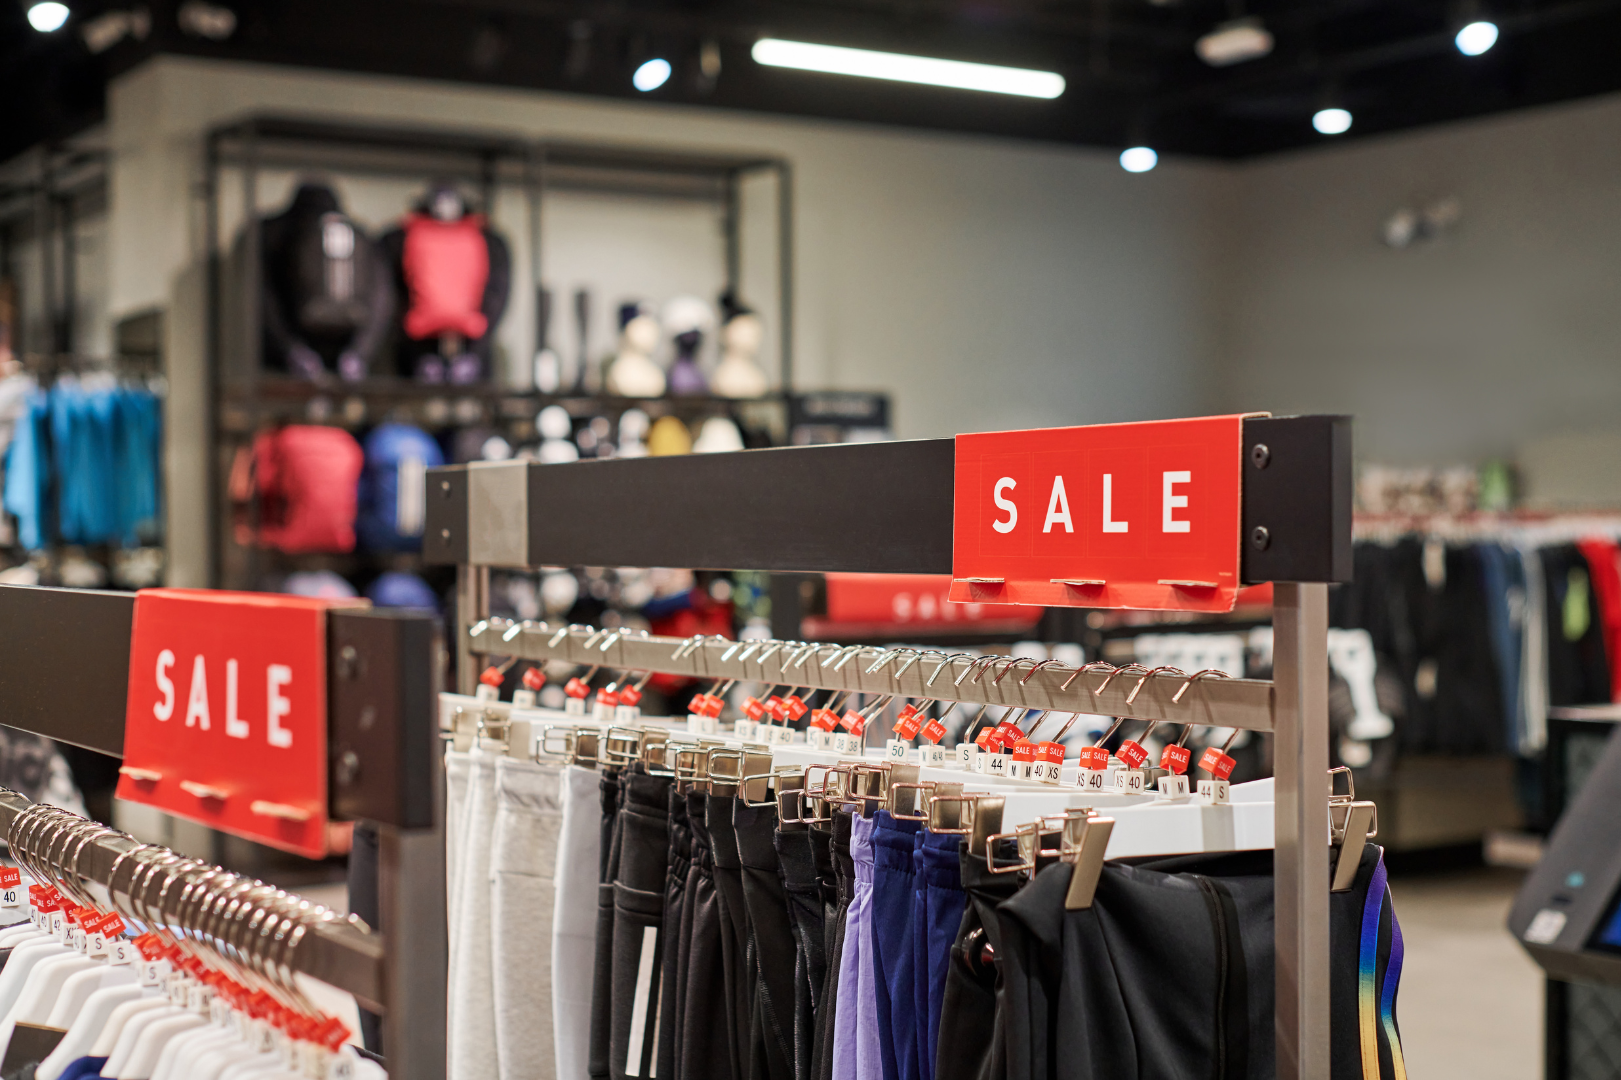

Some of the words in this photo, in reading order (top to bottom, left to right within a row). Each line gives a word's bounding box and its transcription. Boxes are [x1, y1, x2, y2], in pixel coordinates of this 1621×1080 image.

[992, 470, 1191, 534] SALE
[153, 649, 293, 749] SALE
[904, 720, 918, 733] SALE
[928, 724, 944, 736] SALE
[780, 732, 790, 742] 40
[1007, 729, 1021, 742] SALE
[836, 738, 844, 750] 38
[848, 741, 858, 752] 38
[892, 745, 904, 757] 50
[964, 750, 969, 760] S
[1015, 746, 1030, 755] SALE
[1049, 747, 1064, 757] SALE
[1128, 748, 1144, 763] SALE
[1093, 752, 1107, 762] SALE
[1170, 751, 1187, 763] SALE
[1203, 753, 1218, 765] SALE
[991, 759, 1002, 770] 44
[1217, 761, 1231, 774] SALE
[1034, 765, 1043, 777] 40
[1048, 767, 1058, 779] XS
[1089, 774, 1102, 788] 40
[1129, 776, 1140, 789] 40
[1178, 782, 1184, 794] M
[1201, 785, 1211, 798] 44
[1219, 786, 1224, 799] S
[4, 873, 18, 883] SALE
[4, 891, 16, 902] 40
[54, 892, 62, 901] SA
[54, 919, 61, 931] 42
[103, 919, 121, 933] SALE
[95, 938, 102, 950] S
[117, 947, 125, 959] S
[149, 966, 156, 979] S
